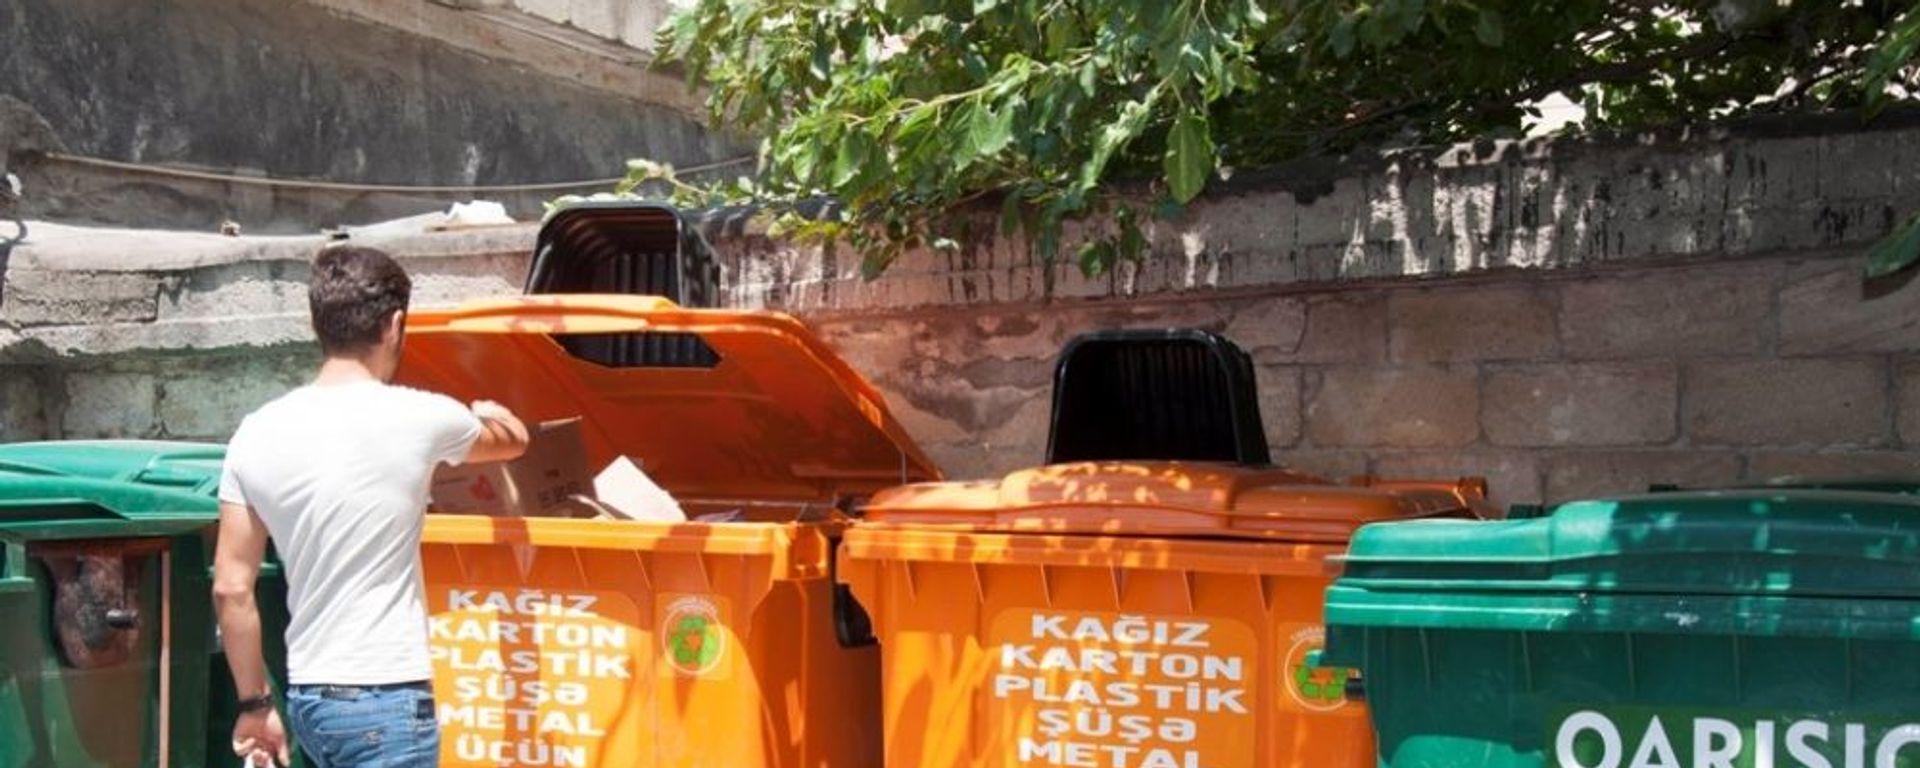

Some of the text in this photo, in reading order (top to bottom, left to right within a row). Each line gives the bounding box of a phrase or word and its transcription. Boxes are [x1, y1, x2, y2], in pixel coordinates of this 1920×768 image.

[449, 588, 598, 618] KAĞIZ
[428, 617, 626, 649] KARTON
[1031, 614, 1211, 648] KAĞIZ
[1002, 645, 1243, 680] KARTON
[995, 675, 1248, 714] PLASTİK
[437, 702, 605, 737] METAL
[455, 733, 587, 768] ÜÇÜN
